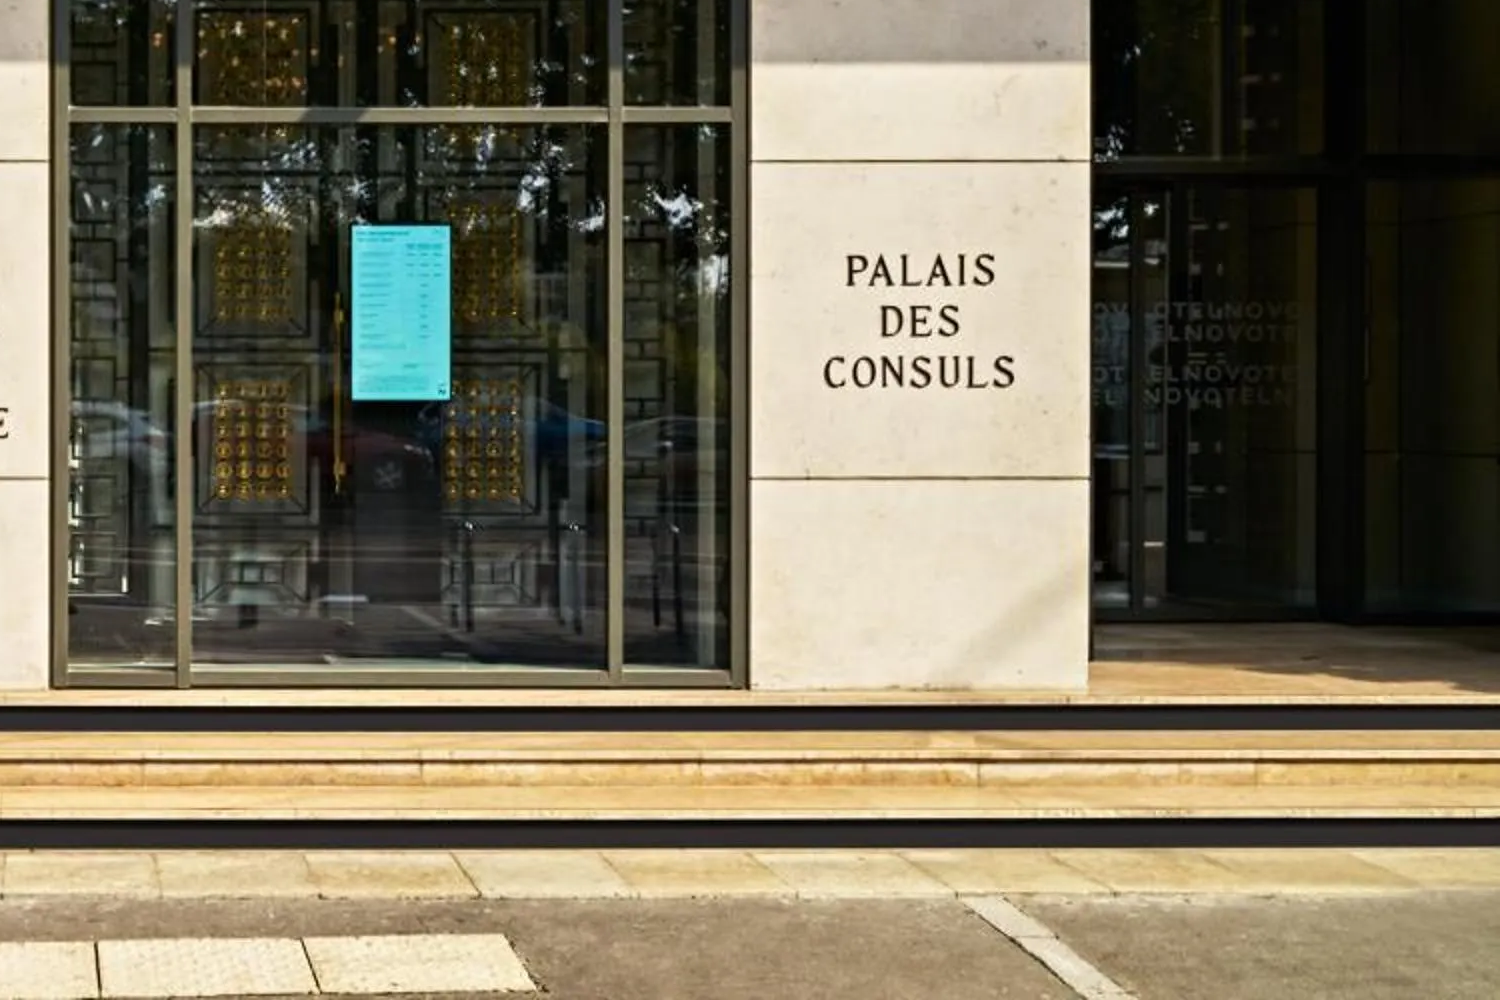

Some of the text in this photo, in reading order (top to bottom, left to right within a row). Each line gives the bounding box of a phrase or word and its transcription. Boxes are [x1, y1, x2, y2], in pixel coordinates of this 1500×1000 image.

[846, 253, 995, 287] PALAIS
[880, 304, 960, 338] DES
[823, 355, 1015, 389] CONSULS
